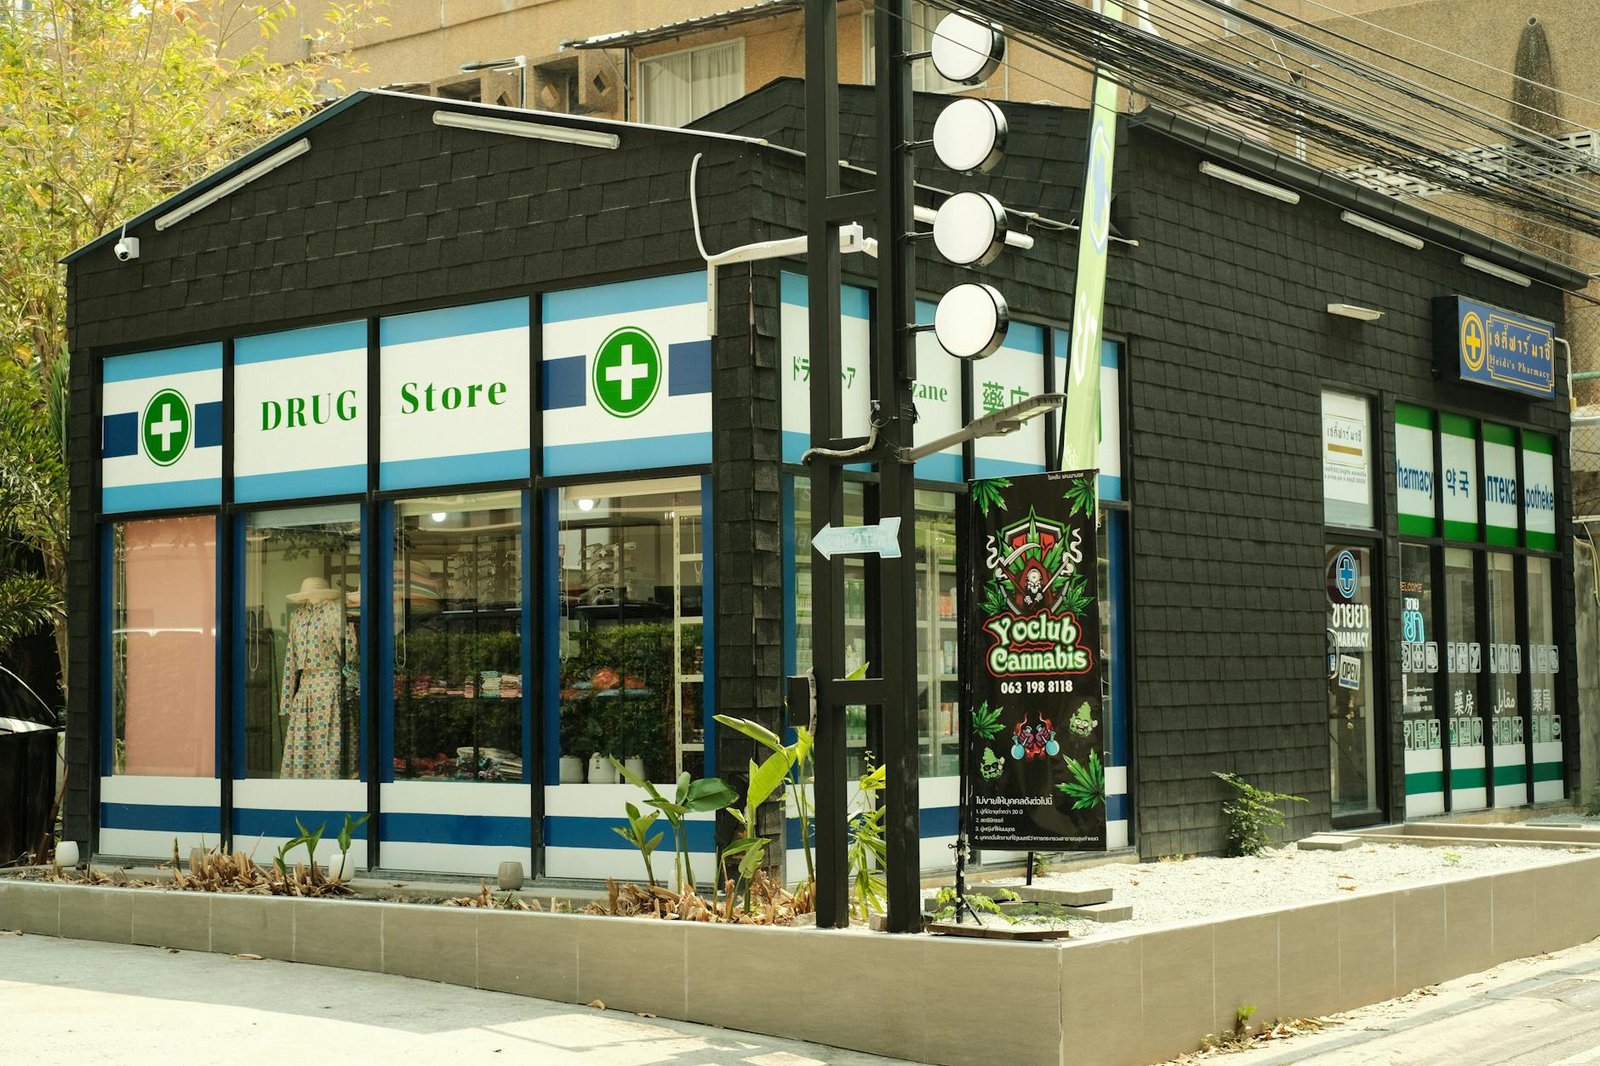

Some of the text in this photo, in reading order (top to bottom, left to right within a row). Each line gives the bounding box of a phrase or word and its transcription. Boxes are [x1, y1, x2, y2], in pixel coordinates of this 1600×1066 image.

[1488, 355, 1551, 382] Heidi's Pharmacy
[261, 381, 507, 431] DRUG Store
[1396, 459, 1433, 500] harmacy
[1445, 468, 1470, 498] 약국
[1332, 603, 1369, 629] ขายยา
[1404, 598, 1420, 611] ขาย
[987, 613, 1077, 646] Yoclub
[1403, 610, 1425, 644] ยา
[990, 645, 1088, 672] Cannabis
[1342, 661, 1359, 682] OPEN
[1001, 680, 1073, 694] 063 198 8118
